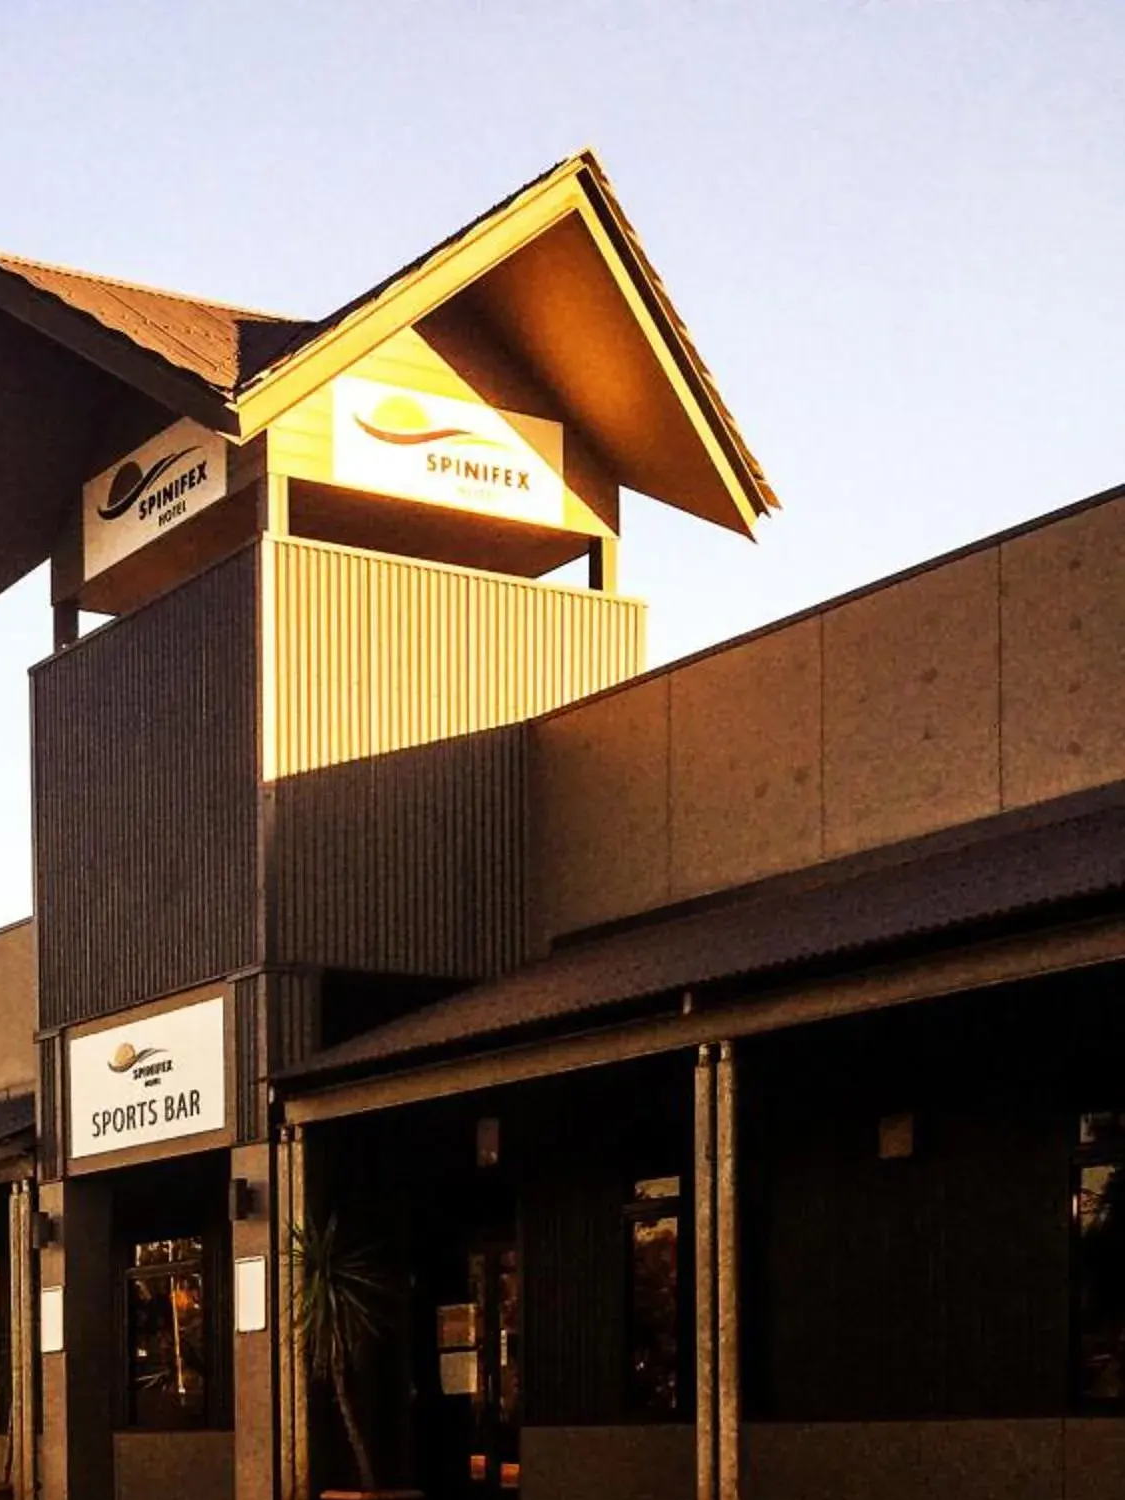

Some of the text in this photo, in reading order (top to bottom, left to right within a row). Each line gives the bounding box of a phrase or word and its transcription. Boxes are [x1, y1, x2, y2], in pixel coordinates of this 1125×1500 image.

[139, 459, 208, 521] SPINIFEX
[426, 453, 531, 490] SPINIFEX
[158, 500, 186, 527] HOTEL
[92, 1089, 201, 1137] SPORTS BAR
